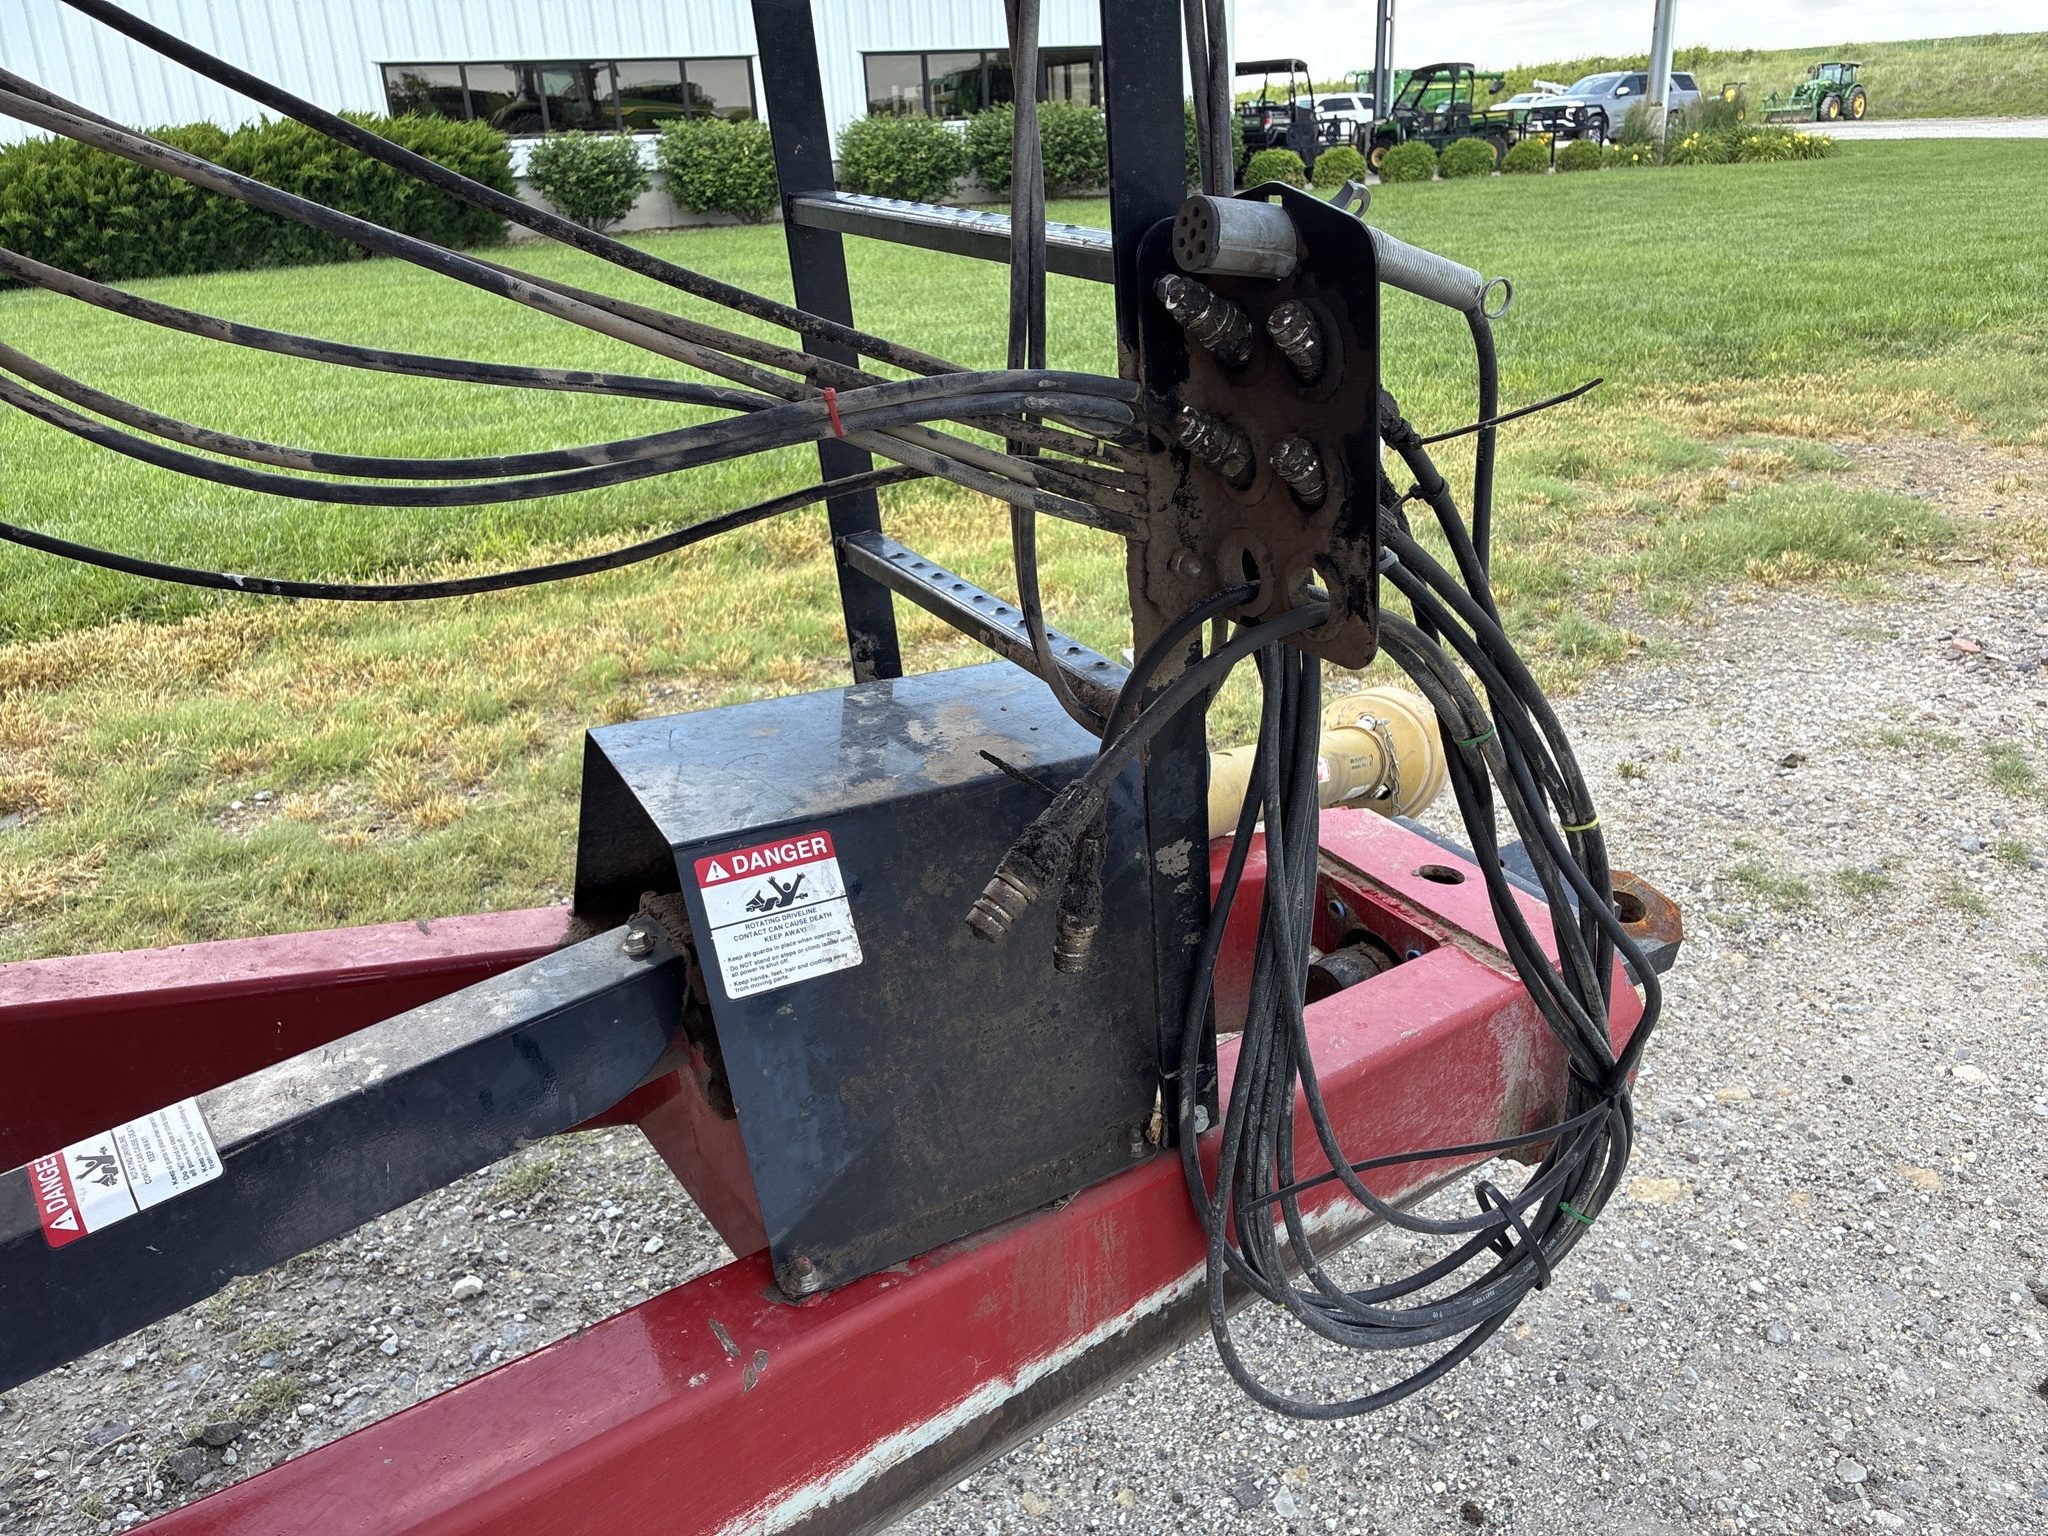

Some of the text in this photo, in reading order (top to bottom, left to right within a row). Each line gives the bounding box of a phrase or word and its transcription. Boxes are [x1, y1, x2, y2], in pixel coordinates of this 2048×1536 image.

[731, 835, 827, 874] DANGER
[733, 911, 832, 941] CONTACT CAN CAUSE DEATH
[744, 907, 817, 930] ROTATING DRIVELINE
[763, 926, 807, 942] KEEP AWAY!
[727, 953, 743, 963] Keep
[752, 946, 773, 957] guards
[780, 940, 796, 949] place
[797, 935, 812, 944] when
[813, 928, 841, 940] operating.
[739, 961, 752, 969] NOT
[753, 956, 770, 965] stand
[780, 949, 796, 959] steps
[804, 943, 820, 951] climb
[821, 938, 839, 947] ladder
[733, 978, 749, 987] Keep
[749, 972, 770, 983] hands,
[770, 968, 784, 977] feet,
[809, 955, 832, 967] clothing
[739, 967, 758, 976] power
[765, 960, 779, 968] shut
[734, 973, 790, 992] from moving parts.
[130, 1137, 141, 1153] CAUSE
[118, 1134, 138, 1180] ROTATING DRIVELINE
[134, 1151, 144, 1163] CAN
[145, 1149, 155, 1162] KEEP
[205, 1154, 215, 1169] from
[177, 1160, 185, 1170] NOT
[197, 1156, 208, 1172] Keep
[138, 1161, 152, 1185] CONTACT
[168, 1169, 179, 1185] Keep
[181, 1170, 189, 1180] Do
